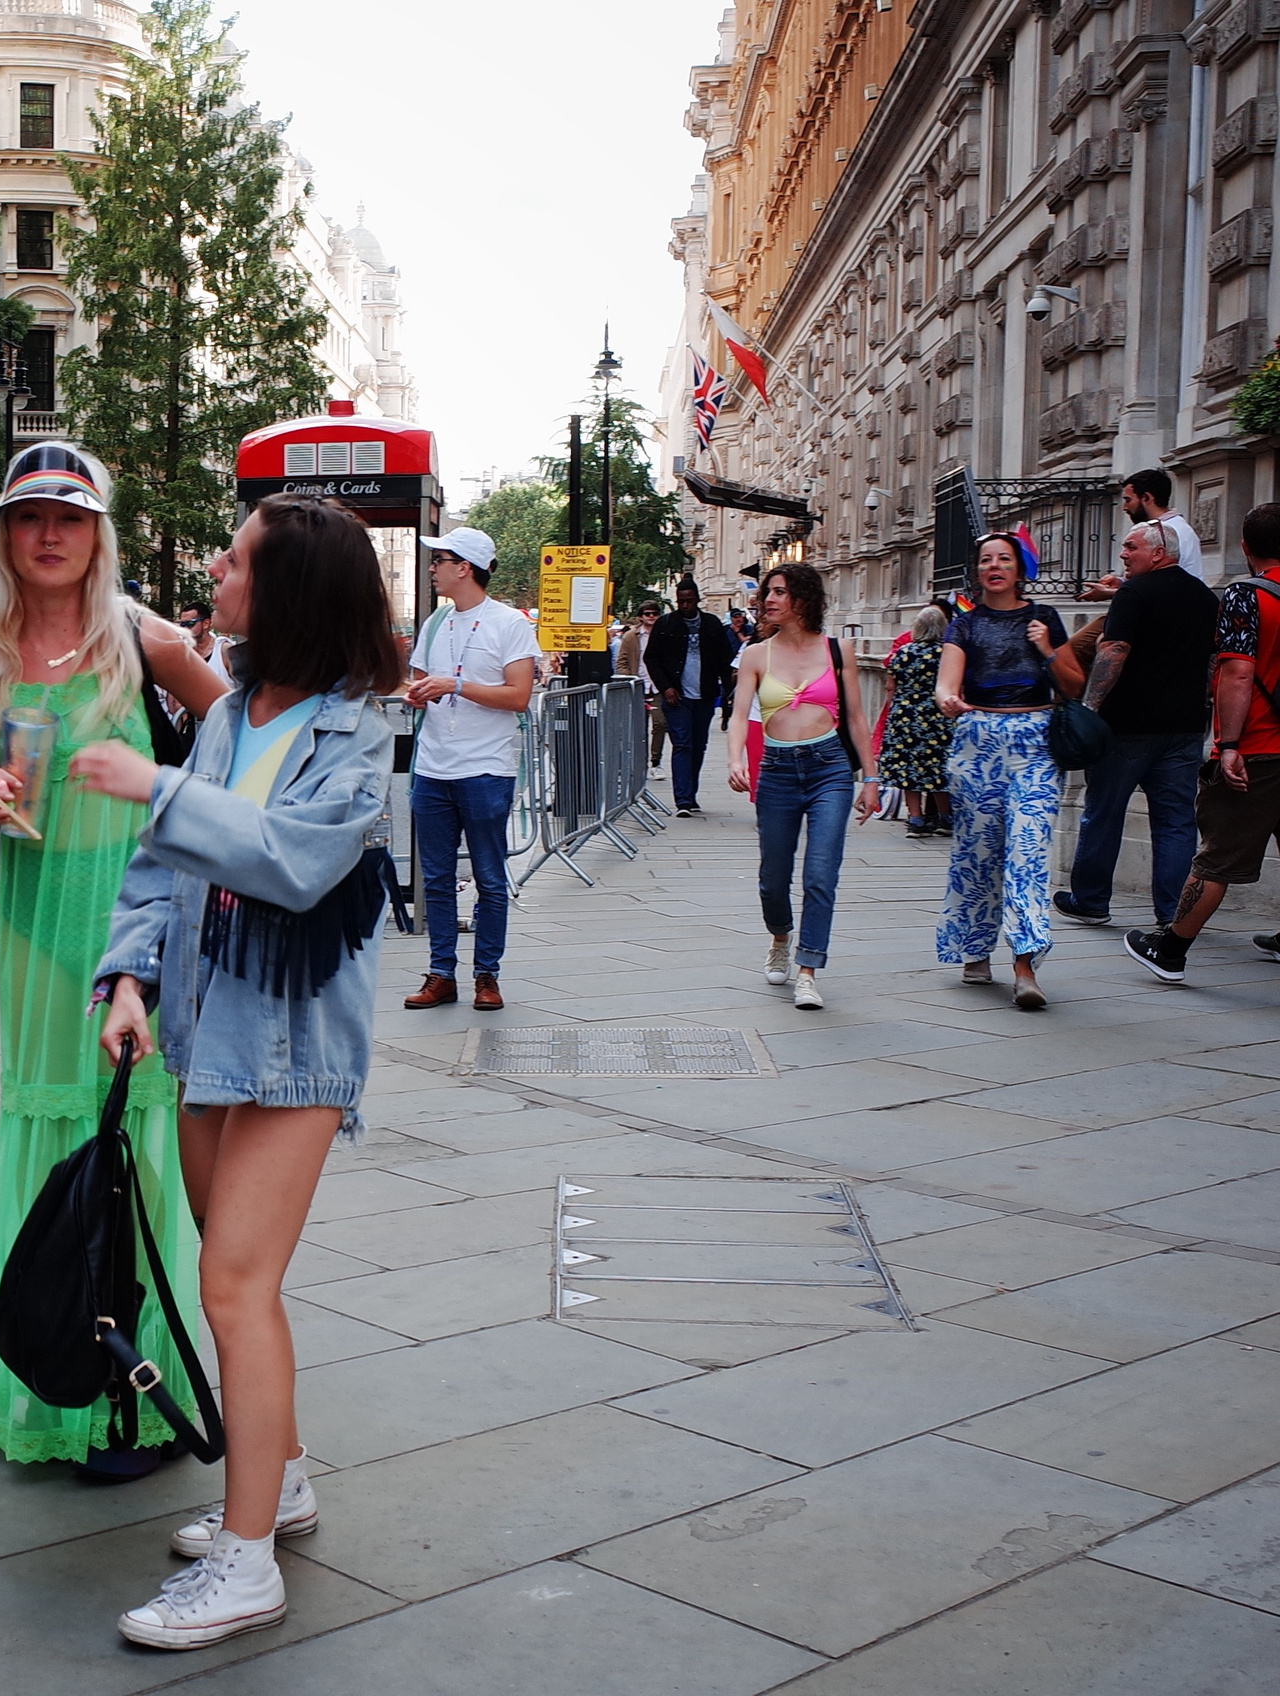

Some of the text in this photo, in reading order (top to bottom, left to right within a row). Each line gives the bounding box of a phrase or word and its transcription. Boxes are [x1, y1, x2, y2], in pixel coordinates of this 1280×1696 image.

[283, 481, 381, 495] Coins & Cards
